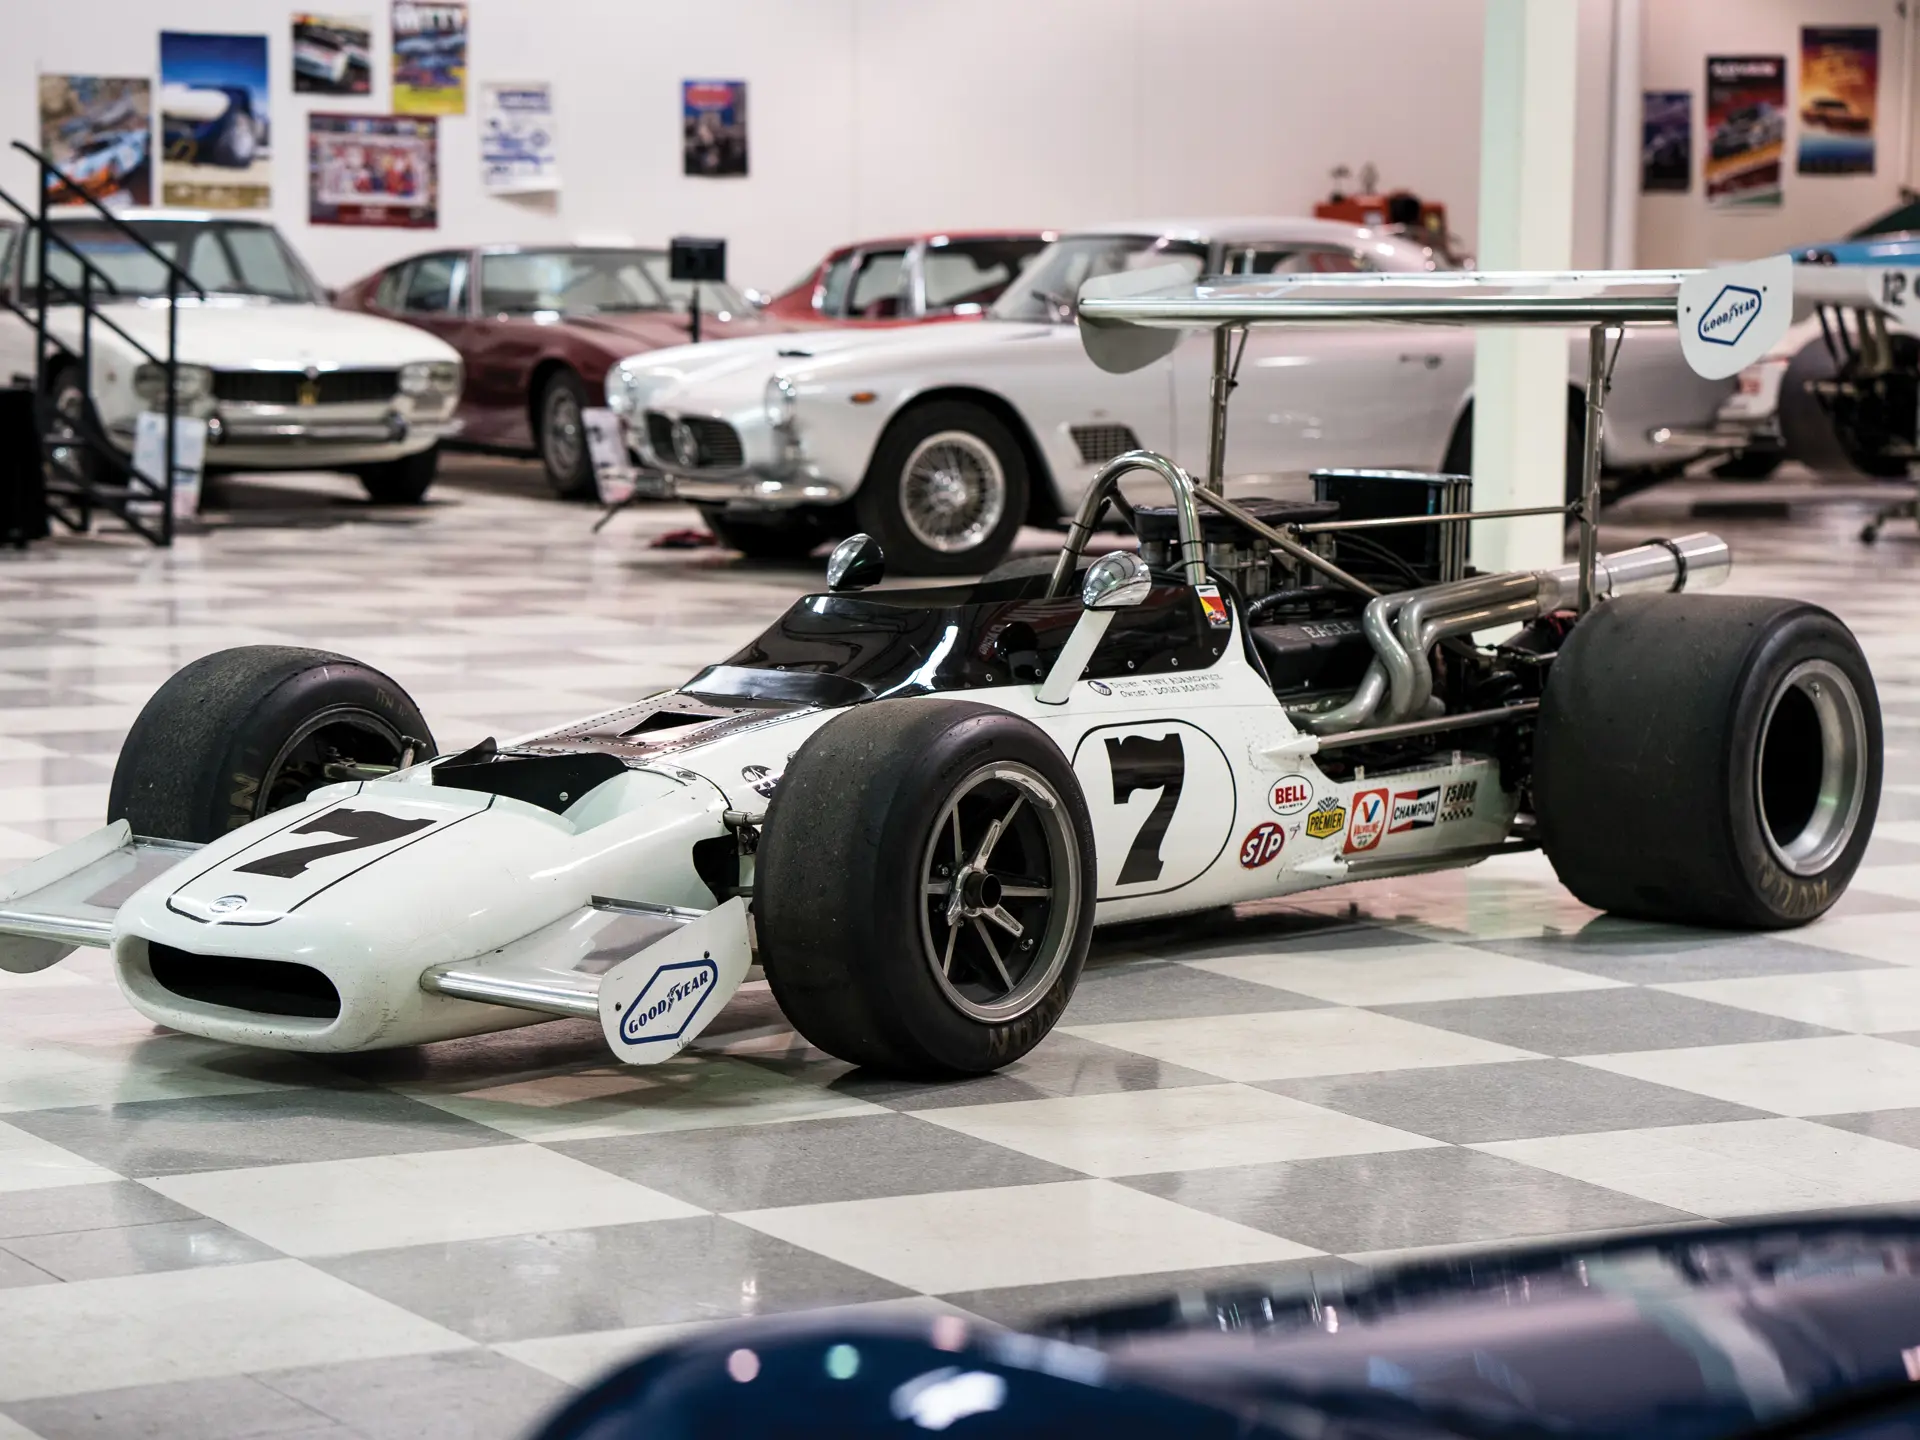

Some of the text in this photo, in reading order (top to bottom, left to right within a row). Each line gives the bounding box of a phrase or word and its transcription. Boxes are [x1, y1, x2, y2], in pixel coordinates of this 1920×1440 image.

[1882, 271, 1907, 307] 12
[1703, 298, 1756, 333] GOODYEAR
[1103, 733, 1185, 886] 7
[1275, 785, 1307, 805] BELL
[1394, 800, 1436, 820] CHAMPION
[1310, 812, 1342, 832] PREMIER
[233, 808, 437, 879] 7
[1242, 826, 1282, 865] STP
[628, 970, 708, 1034] GOODYEAR
